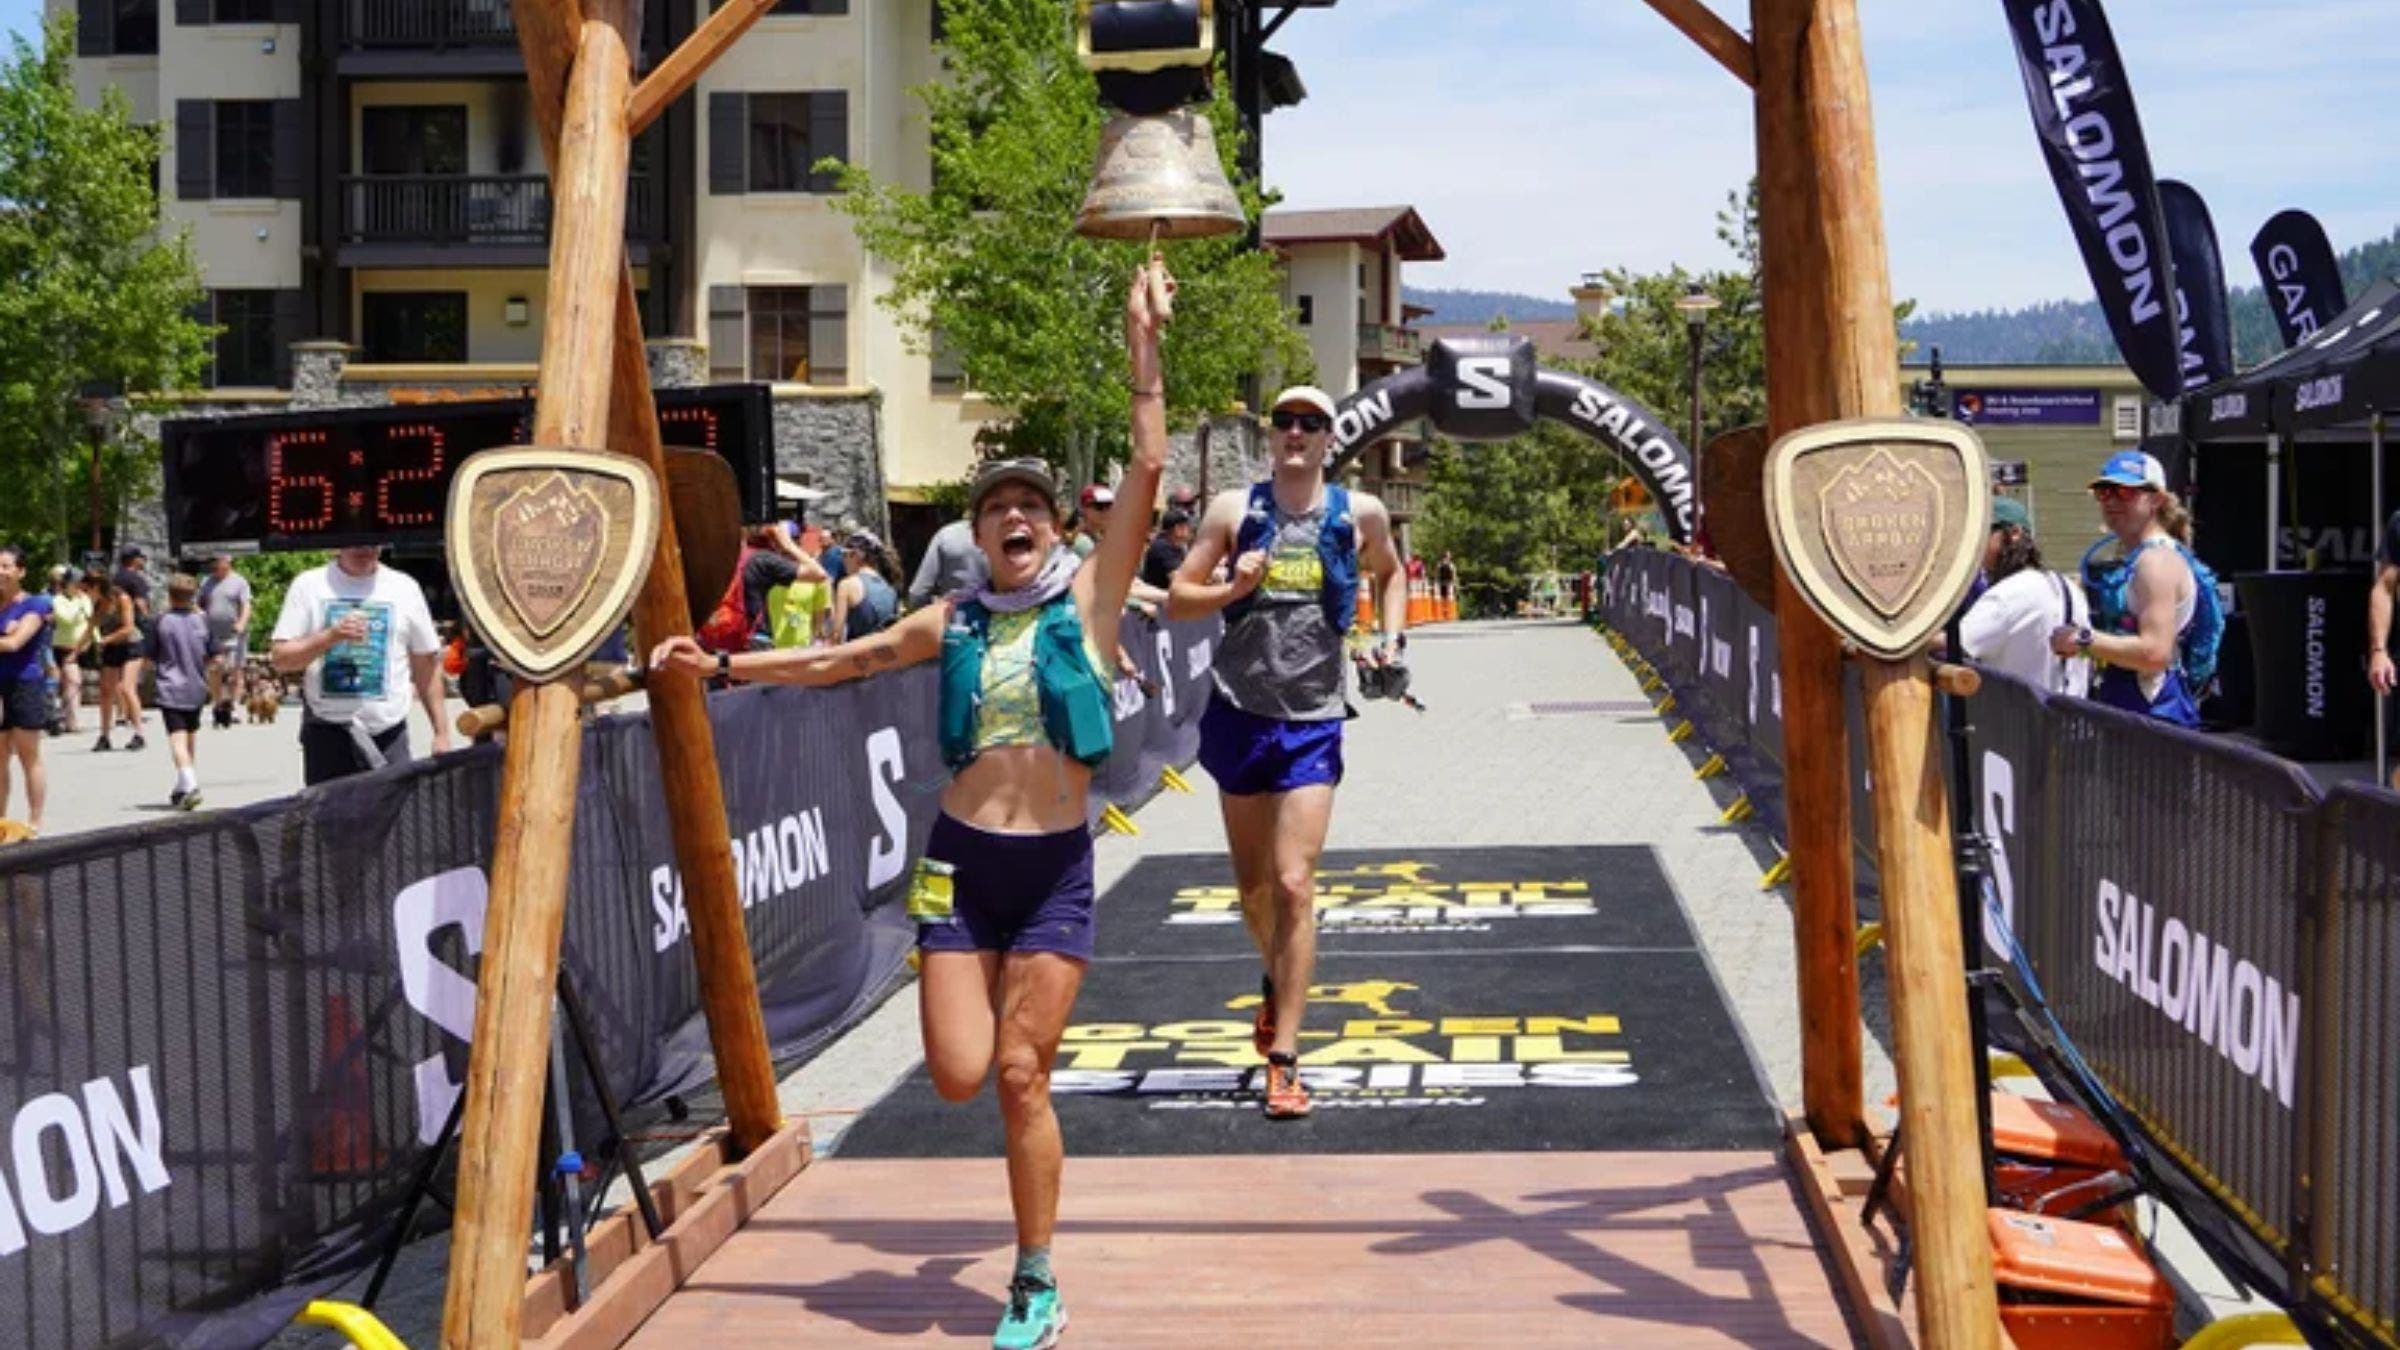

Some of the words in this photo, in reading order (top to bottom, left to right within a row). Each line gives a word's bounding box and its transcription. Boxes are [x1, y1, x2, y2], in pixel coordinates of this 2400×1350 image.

[2033, 0, 2161, 324] SALOMON
[1456, 358, 1510, 409] S
[2306, 597, 2326, 719] SALOMON
[2096, 878, 2300, 1110] SALOMON
